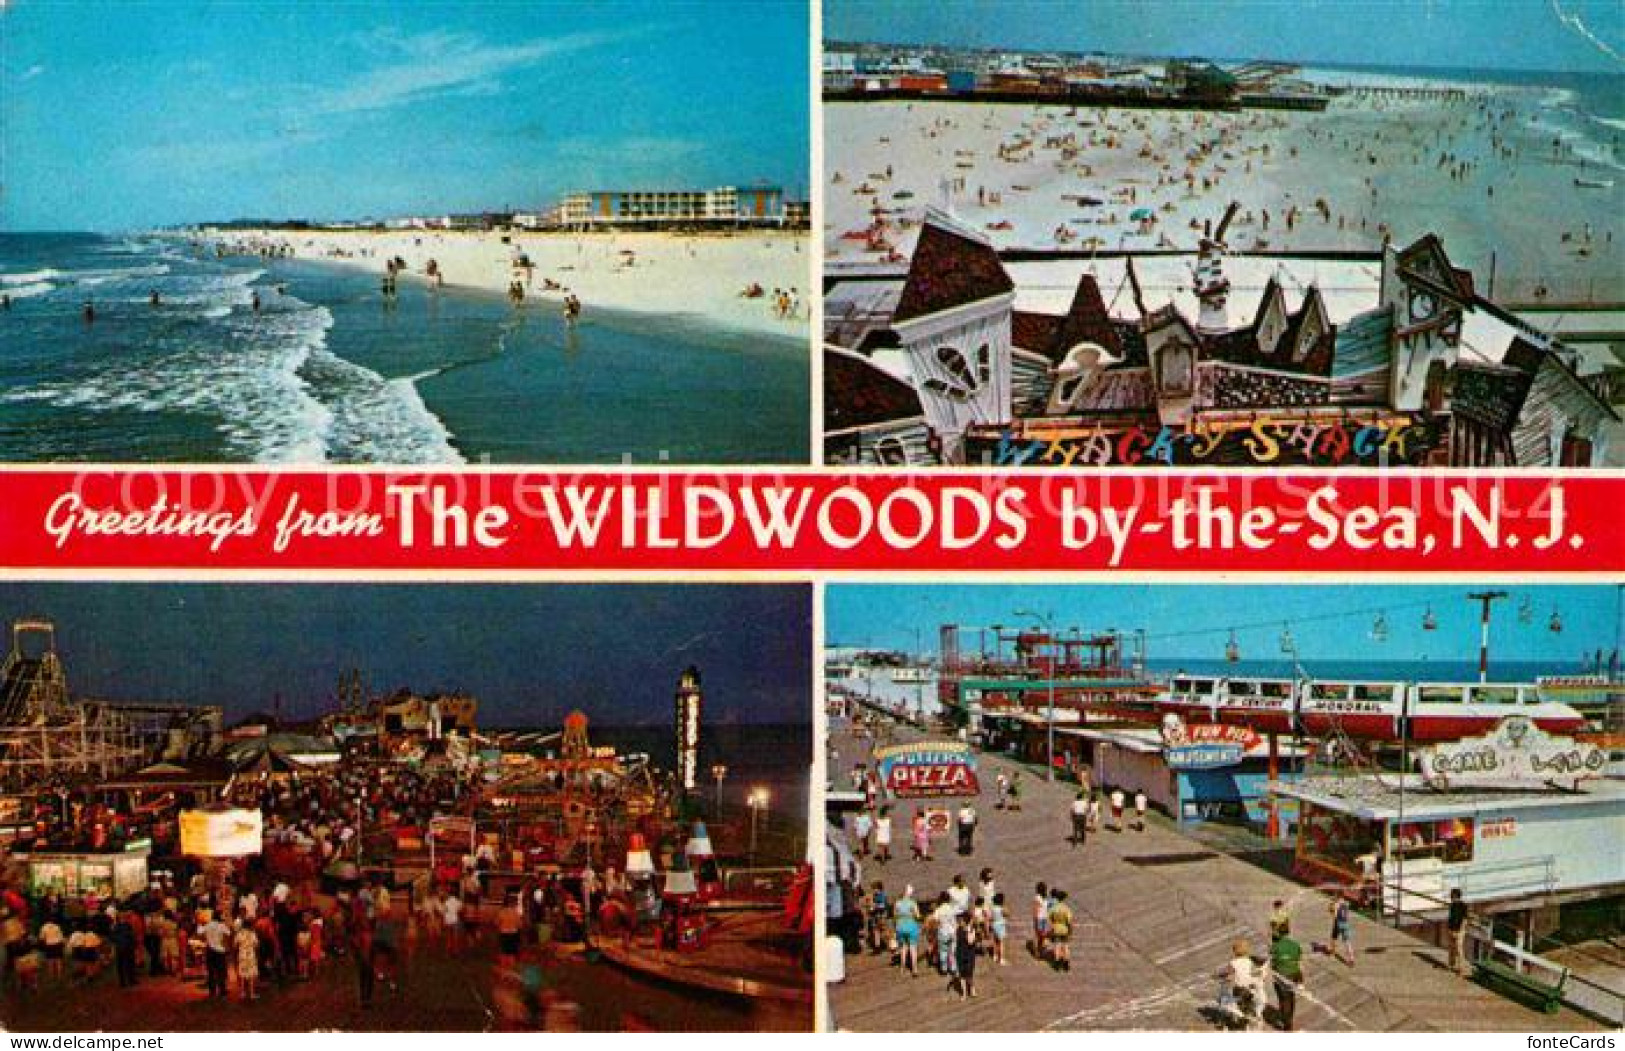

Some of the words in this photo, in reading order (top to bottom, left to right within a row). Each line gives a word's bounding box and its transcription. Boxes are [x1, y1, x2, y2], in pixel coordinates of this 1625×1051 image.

[1243, 417, 1412, 461] SHACK
[45, 492, 256, 553] Greetings
[273, 491, 384, 552] from
[387, 485, 510, 549] The
[541, 485, 1028, 550] WILDWOODS
[1061, 486, 1436, 567] by-the-Sea,
[893, 765, 969, 786] PIZZA
